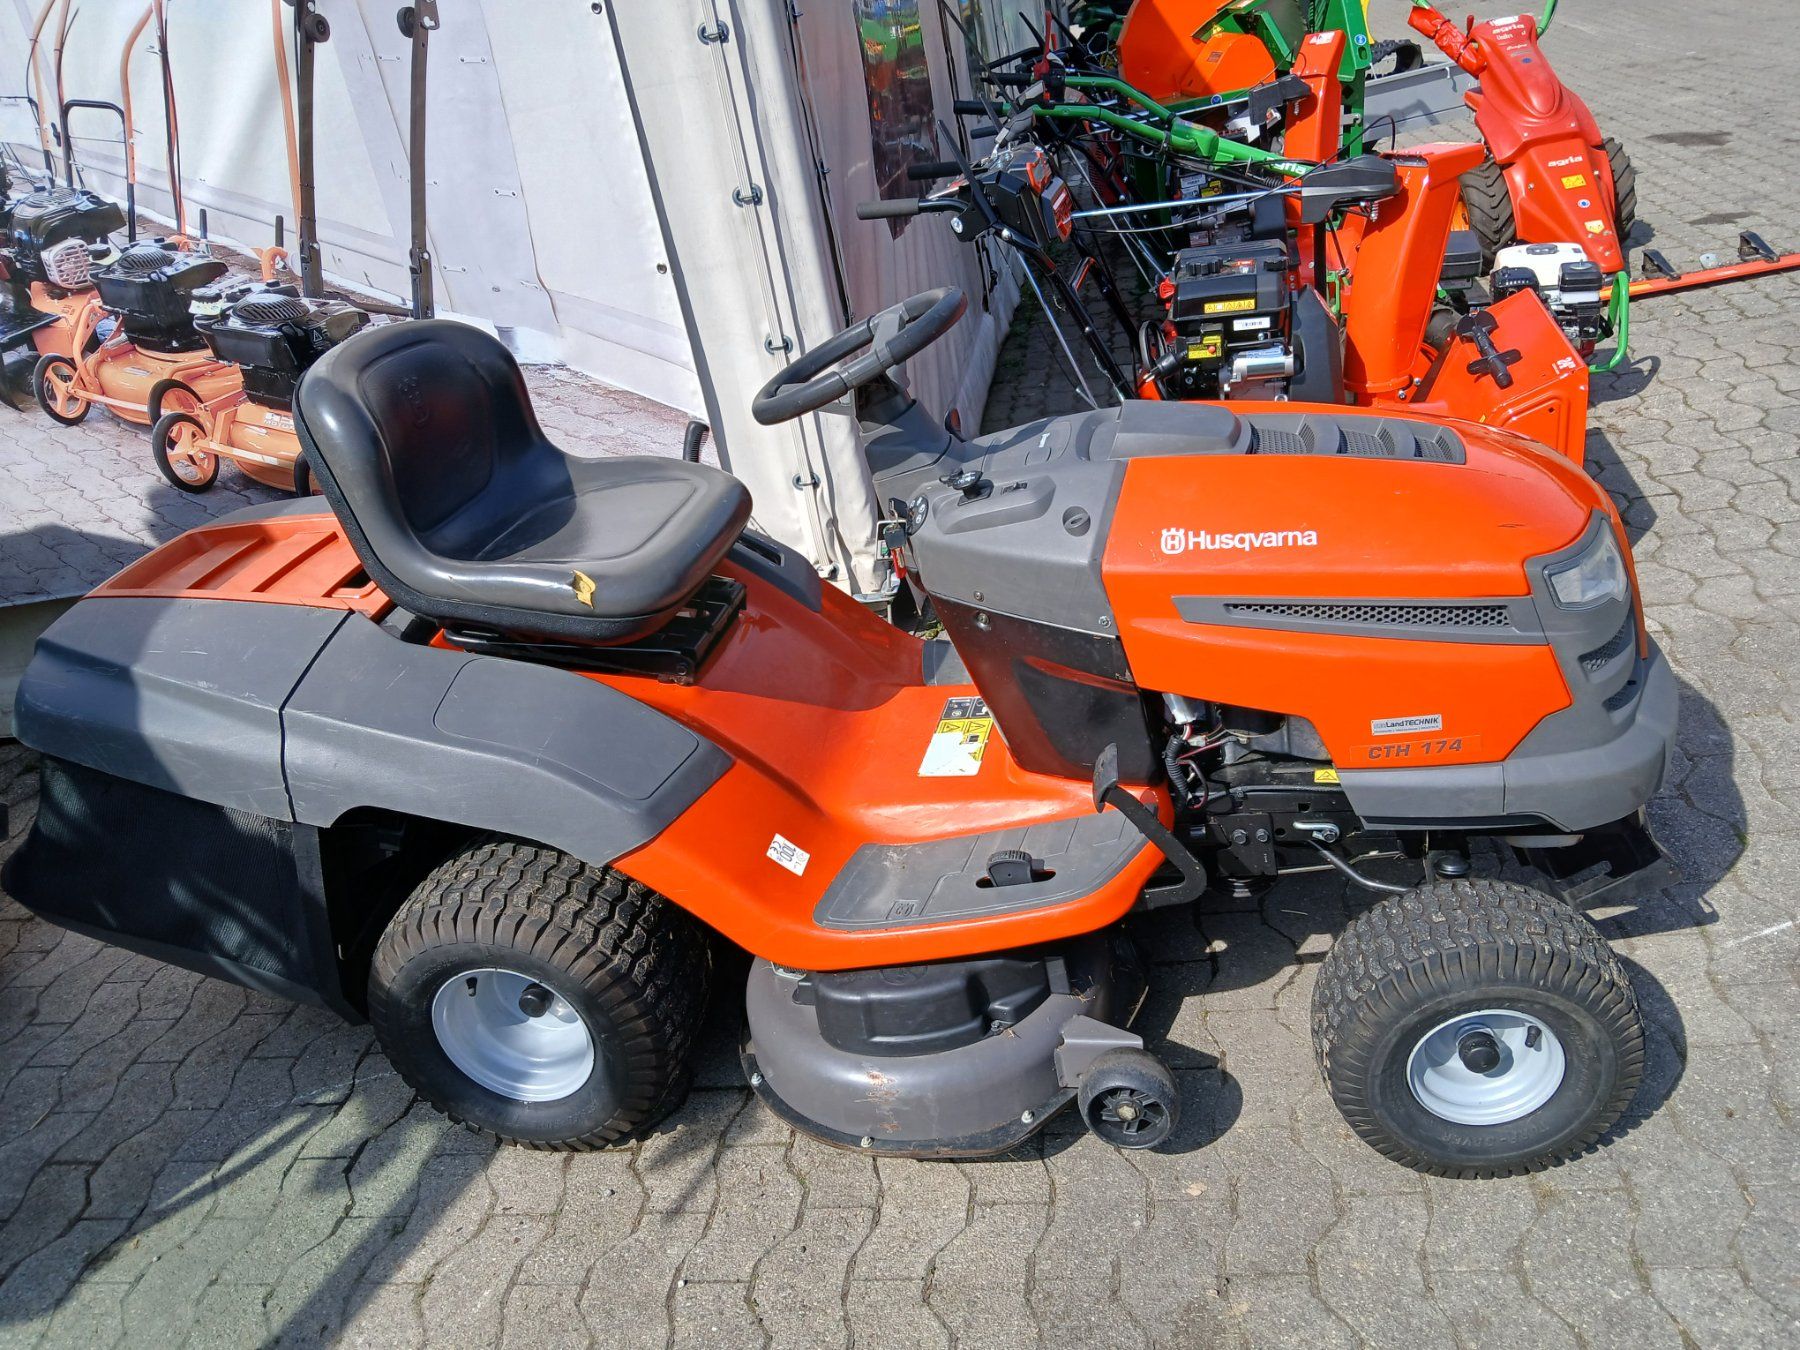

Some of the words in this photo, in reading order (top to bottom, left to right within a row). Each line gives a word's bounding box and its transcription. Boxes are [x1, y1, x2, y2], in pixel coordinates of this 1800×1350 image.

[1548, 155, 1583, 167] agria
[1188, 529, 1317, 552] Husqvarna
[1368, 744, 1411, 760] CTH
[1421, 739, 1462, 755] 174
